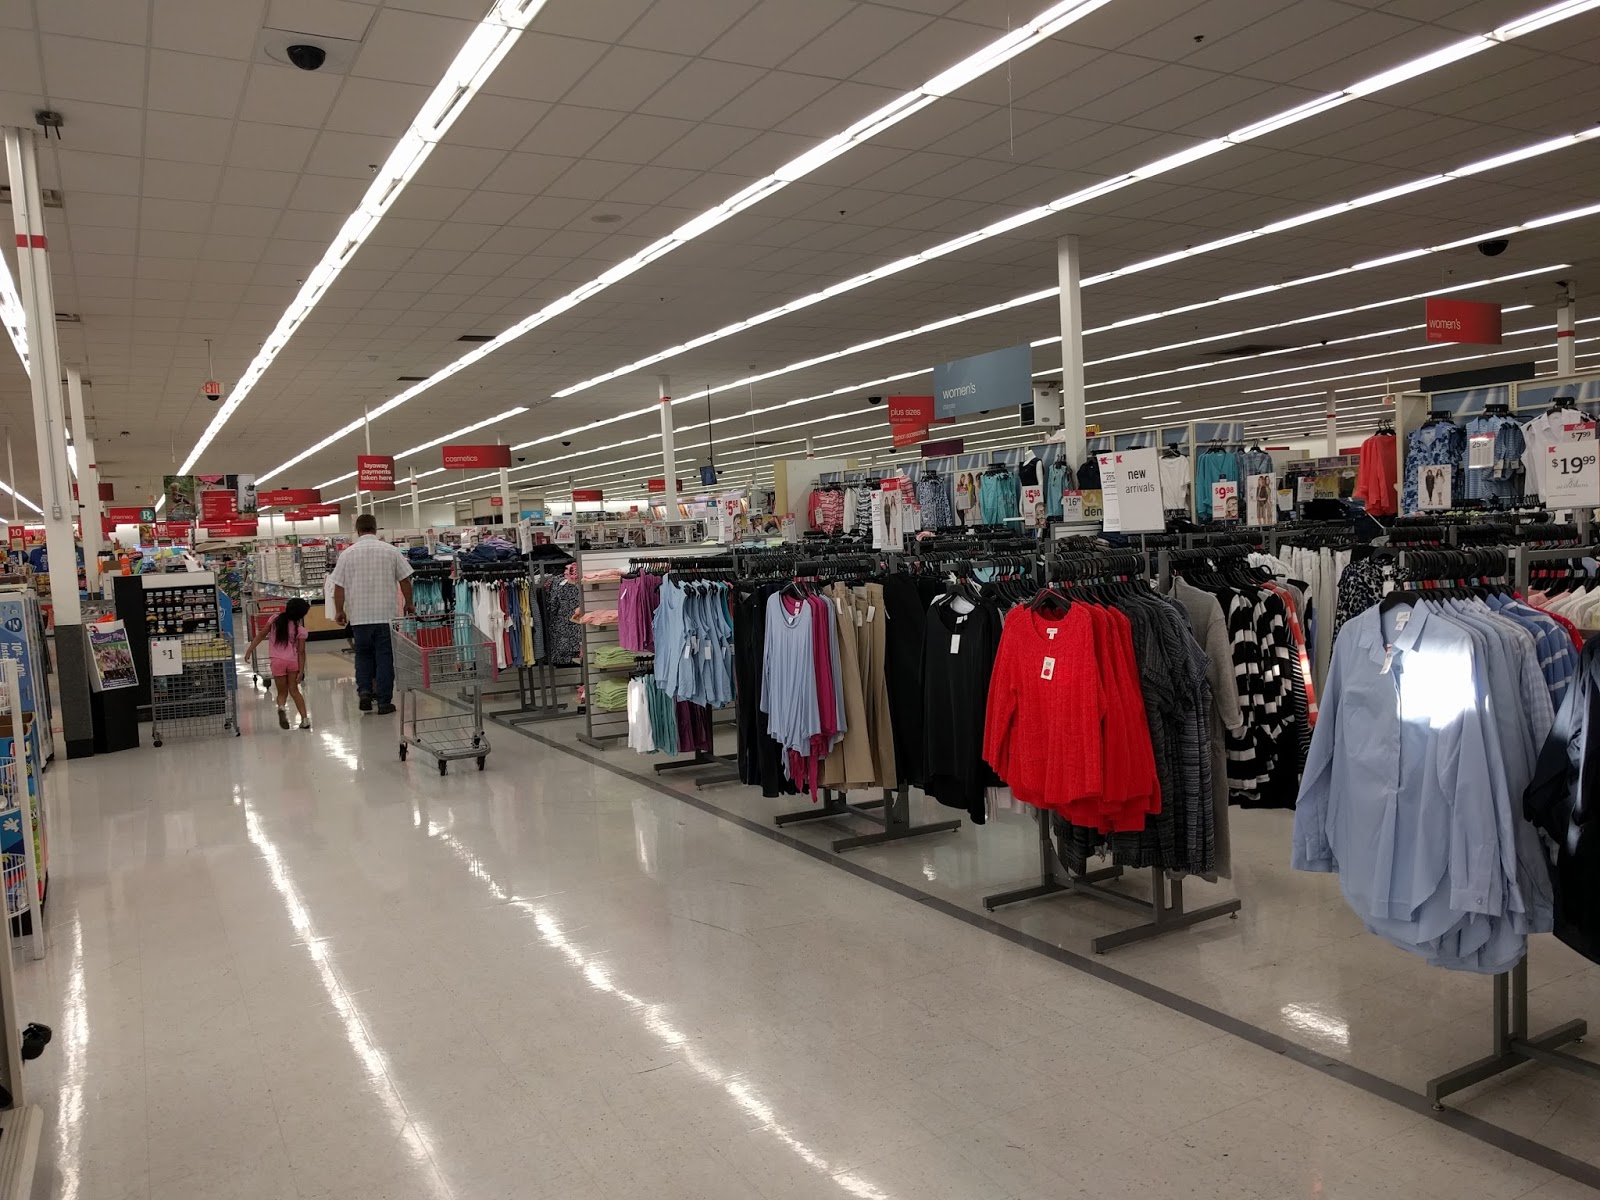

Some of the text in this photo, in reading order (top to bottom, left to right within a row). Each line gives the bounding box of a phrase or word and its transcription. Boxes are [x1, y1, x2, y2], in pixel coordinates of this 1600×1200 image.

[1429, 318, 1461, 330] women's
[205, 382, 220, 394] EXIT
[942, 383, 976, 400] women's
[890, 408, 921, 417] plus sizes
[445, 454, 478, 463] cosmetics
[1127, 469, 1146, 480] new
[1125, 482, 1155, 494] arrivals
[1084, 506, 1103, 517] den
[11, 528, 22, 537] 10
[162, 649, 174, 660] $1
